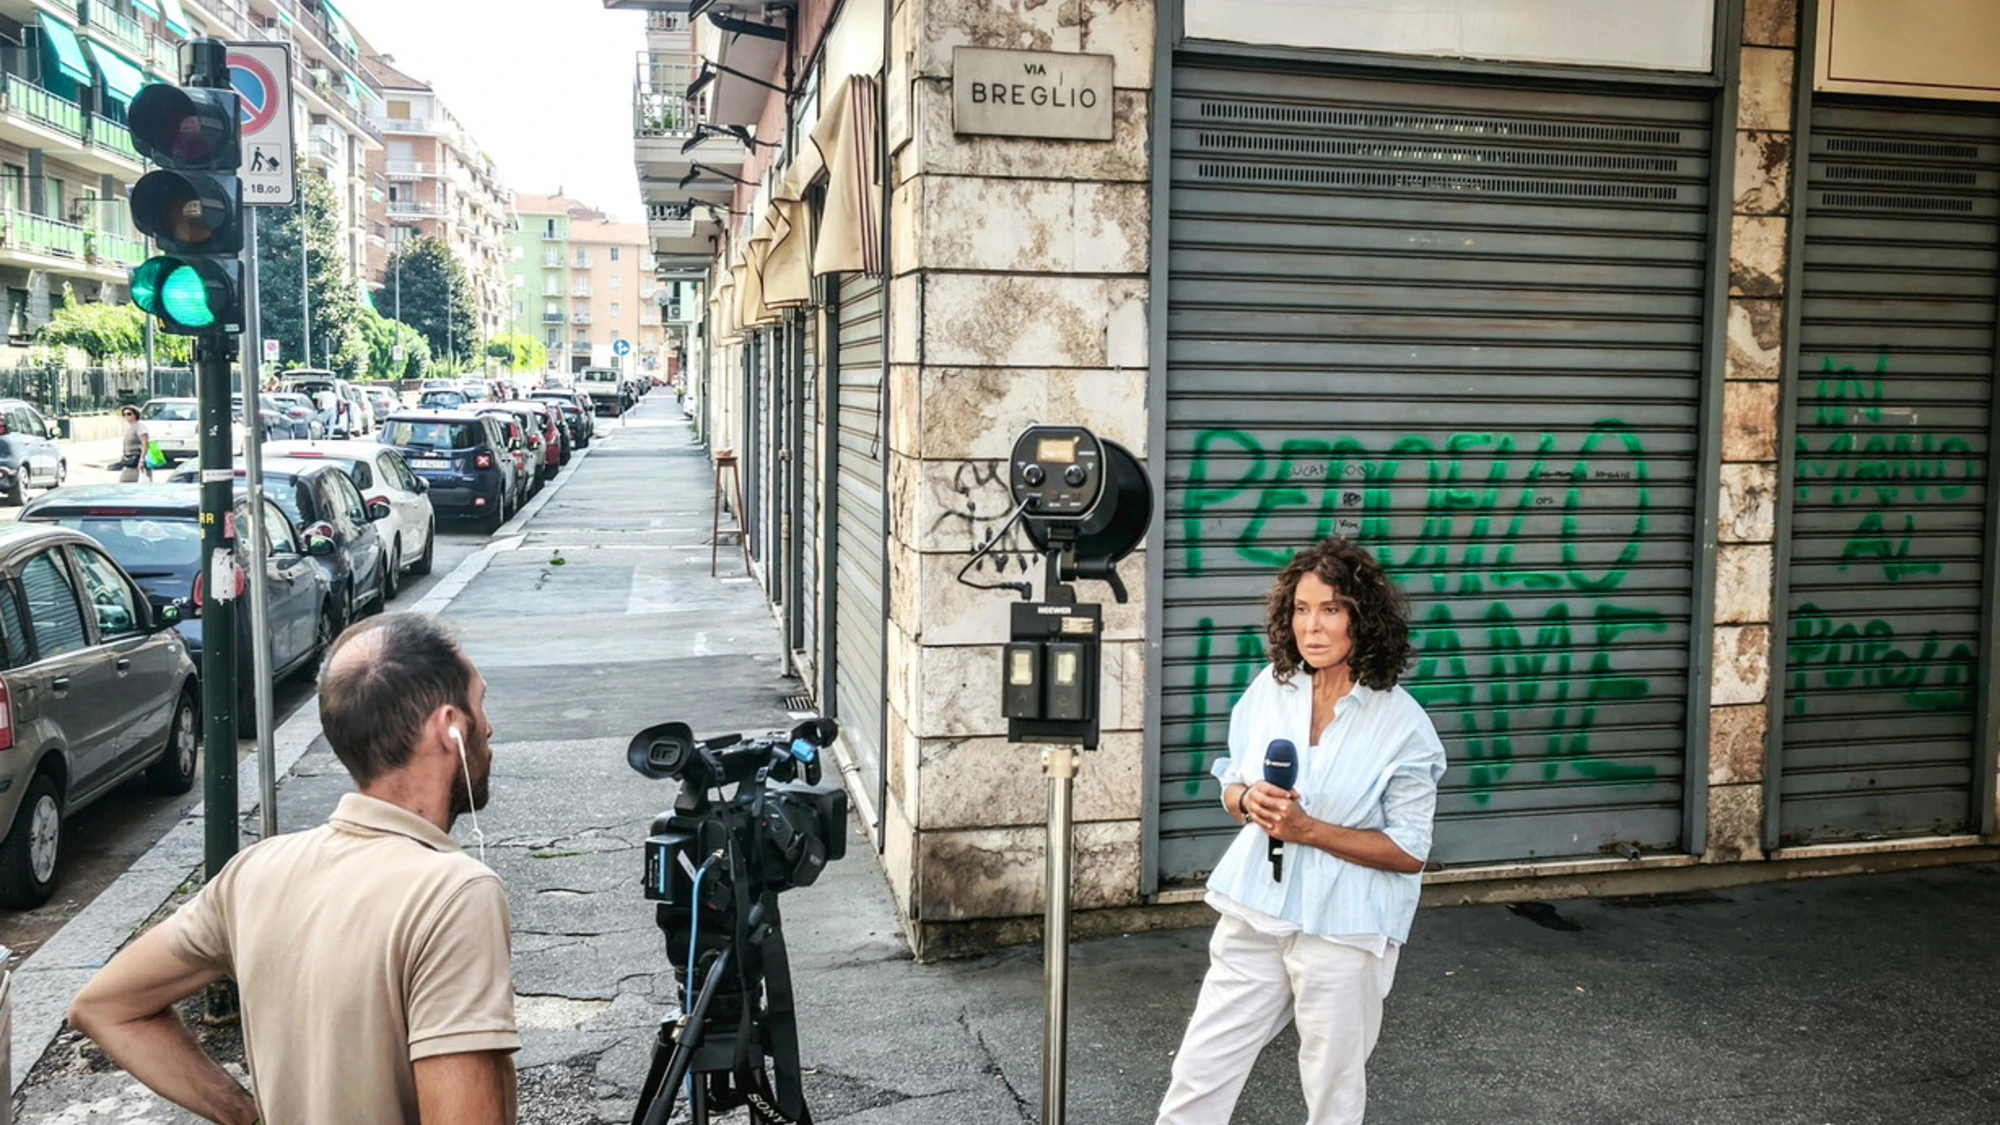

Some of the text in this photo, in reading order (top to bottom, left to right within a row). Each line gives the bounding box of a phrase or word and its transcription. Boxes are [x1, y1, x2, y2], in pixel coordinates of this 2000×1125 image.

[972, 82, 1096, 109] BREGLIO
[1024, 64, 1046, 76] VIA
[1815, 346, 1890, 426] IN
[1796, 434, 1973, 506] MANO
[1183, 418, 1650, 595] PEDOFILO
[1836, 513, 1942, 582] AL
[1184, 602, 1669, 806] IAME
[747, 1093, 788, 1123] SONY
